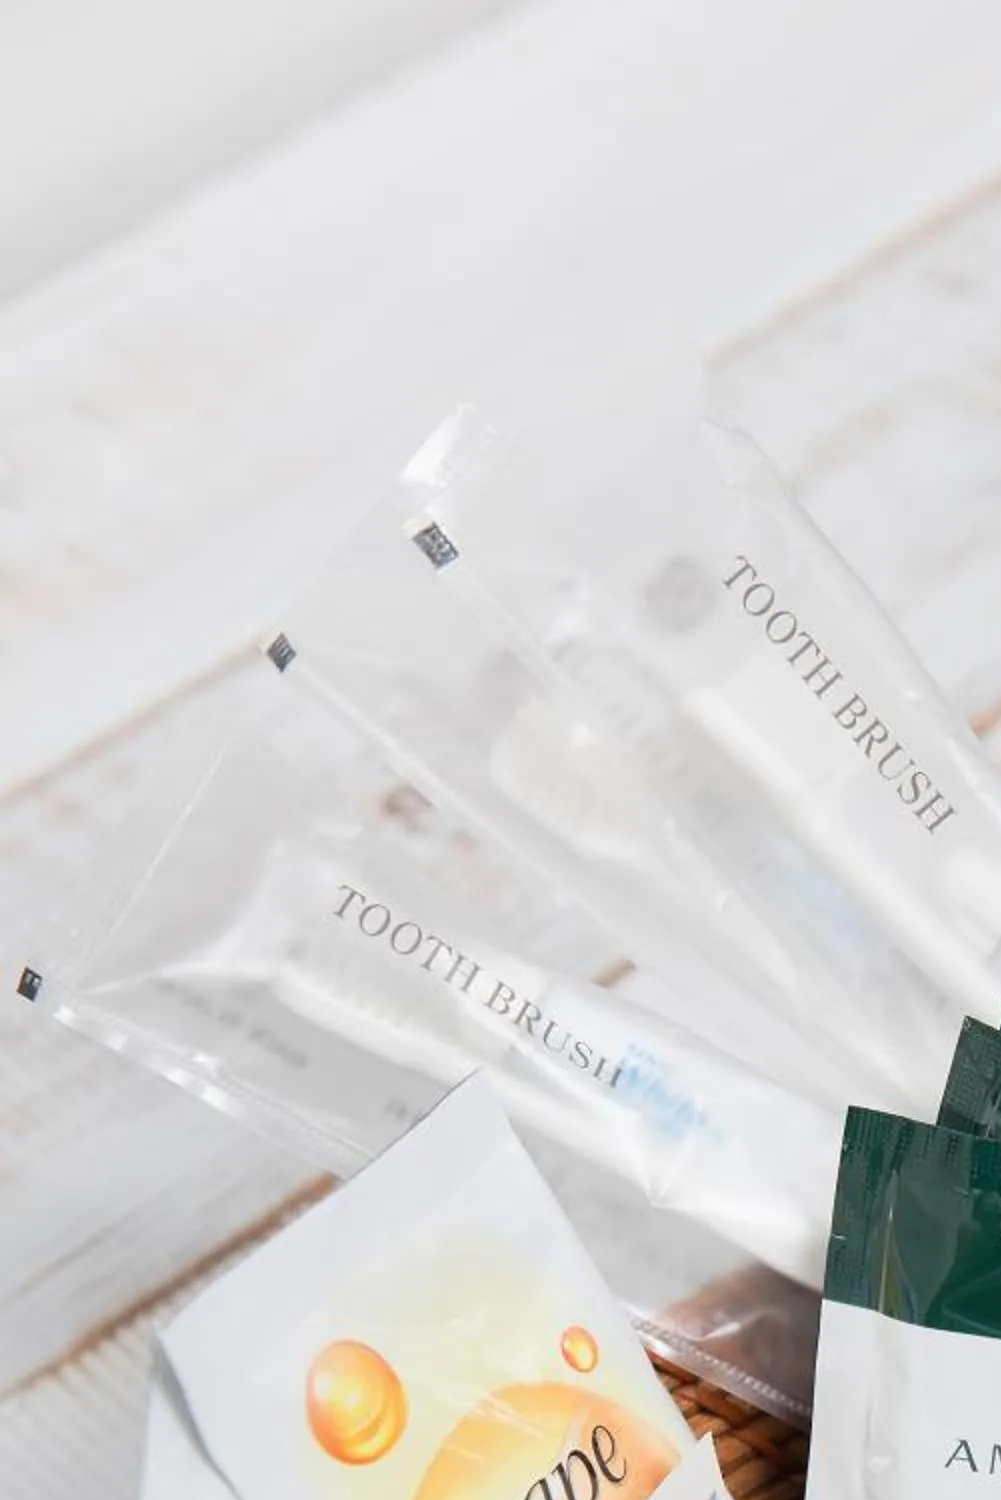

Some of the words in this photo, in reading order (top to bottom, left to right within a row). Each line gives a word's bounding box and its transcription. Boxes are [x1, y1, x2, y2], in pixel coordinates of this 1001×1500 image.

[722, 554, 844, 700] TOOTH
[831, 692, 959, 837] BRUSH
[333, 884, 482, 994] TOOTH
[483, 978, 626, 1089] BRUSH
